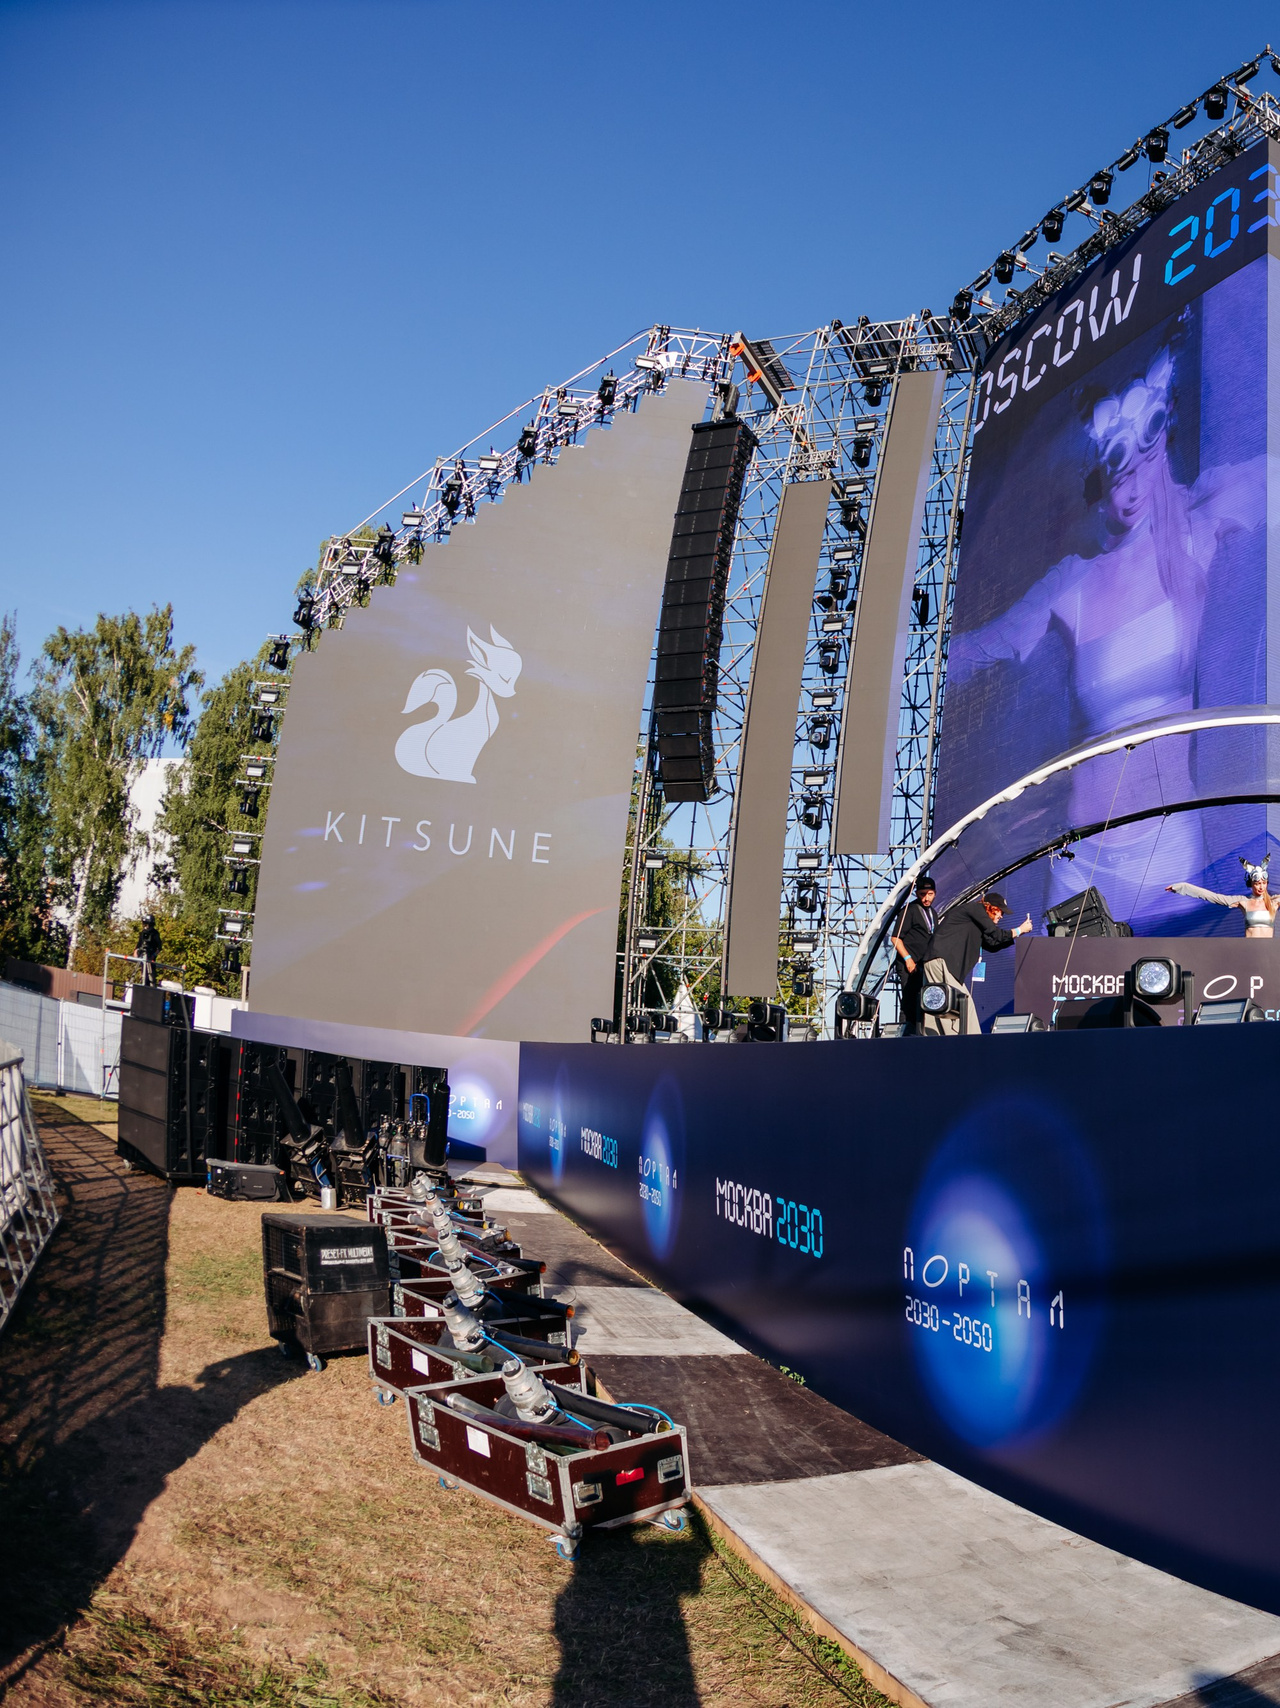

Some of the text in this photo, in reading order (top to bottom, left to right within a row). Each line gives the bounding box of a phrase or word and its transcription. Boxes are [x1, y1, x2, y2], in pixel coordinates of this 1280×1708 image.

[324, 811, 552, 864] KITSUNE
[449, 1094, 502, 1110] ОРТАЛ
[716, 1177, 823, 1258] МОСКВА 2030
[903, 1246, 1064, 1329] ПОРТАЛ
[905, 1295, 992, 1352] 2030-2050
